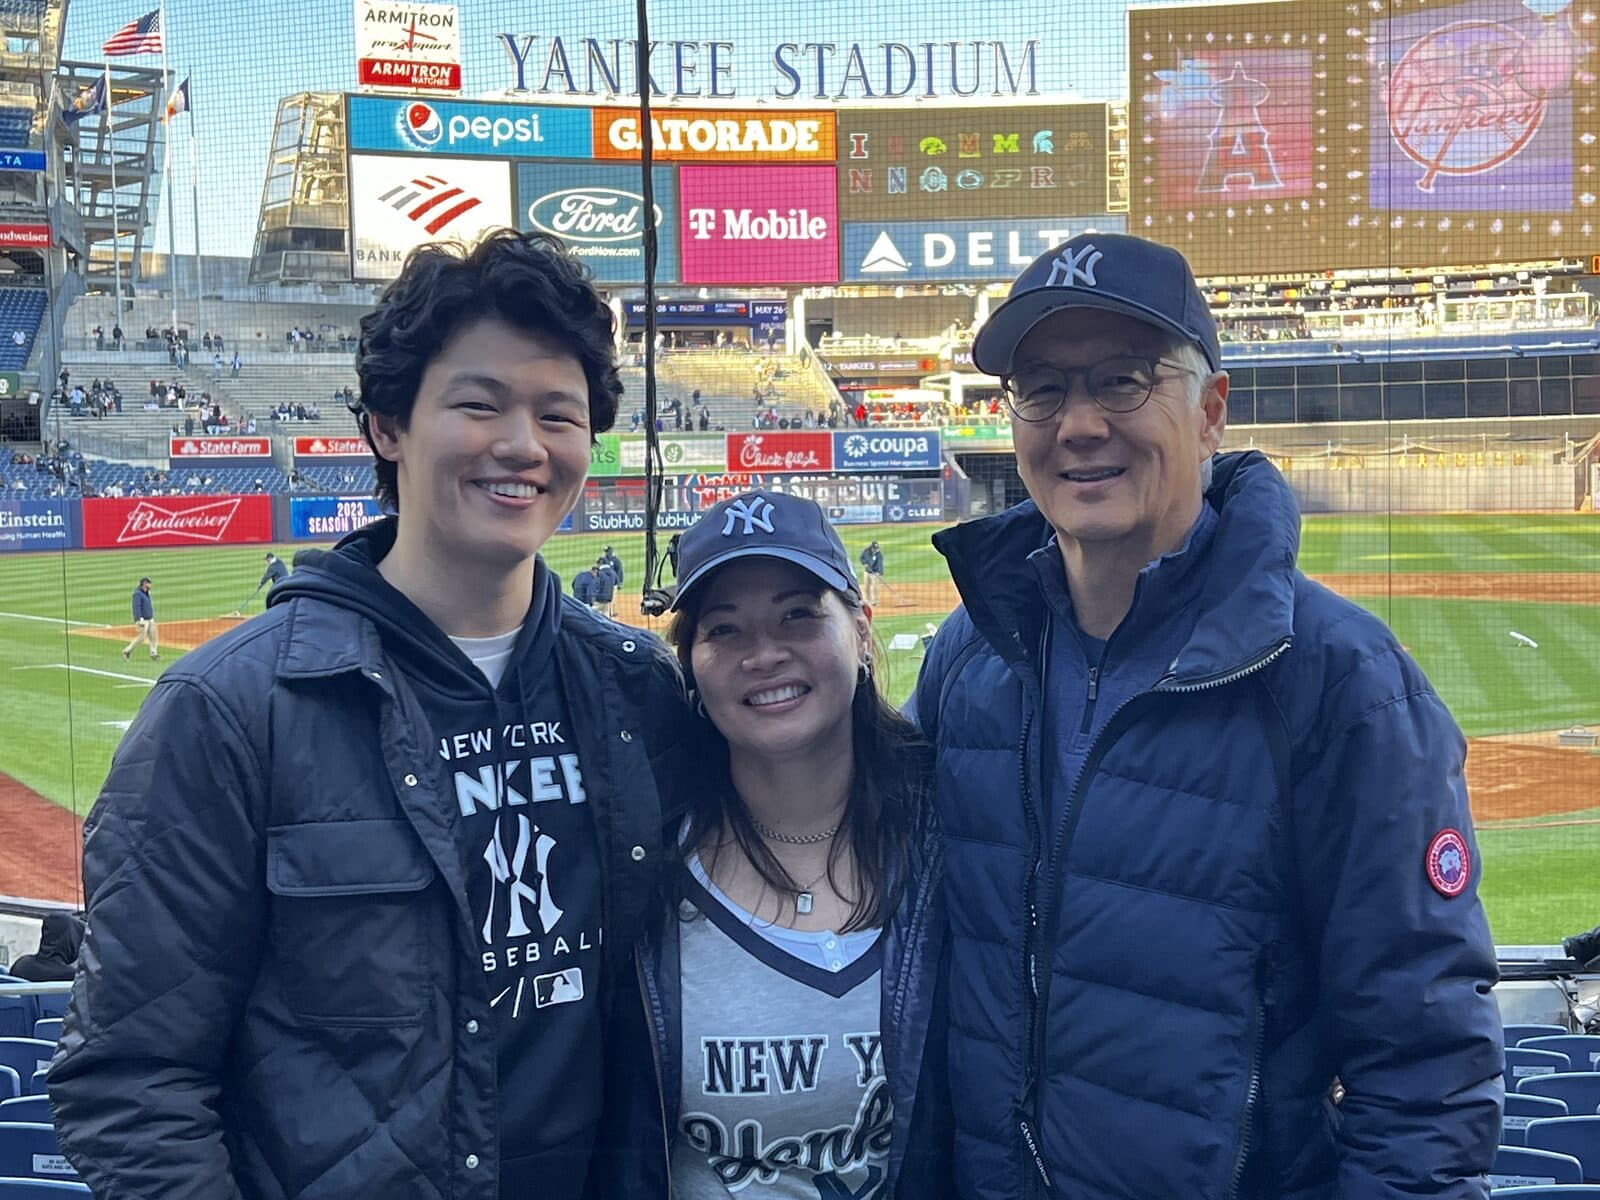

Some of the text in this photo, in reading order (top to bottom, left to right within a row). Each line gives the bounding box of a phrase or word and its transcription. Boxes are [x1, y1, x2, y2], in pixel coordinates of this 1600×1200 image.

[365, 8, 453, 27] ARMITRON
[371, 62, 450, 78] ARMITRON
[496, 33, 1040, 99] YANKEE STADIUM
[411, 76, 449, 86] WATCHES
[448, 113, 540, 146] pepsi
[608, 118, 820, 152] GATORADE
[552, 194, 637, 233] Ford
[723, 209, 826, 241] Mobile
[356, 249, 402, 262] BANK
[924, 229, 1097, 267] DELT
[870, 437, 928, 456] coupa
[0, 510, 63, 528] Einstein
[337, 502, 364, 517] 2023
[722, 496, 775, 535] NY
[908, 508, 940, 517] CLEAR
[128, 511, 229, 531] Budweiser
[309, 516, 349, 533] SEASON
[590, 514, 643, 529] StubHub
[701, 1034, 829, 1096] NEW
